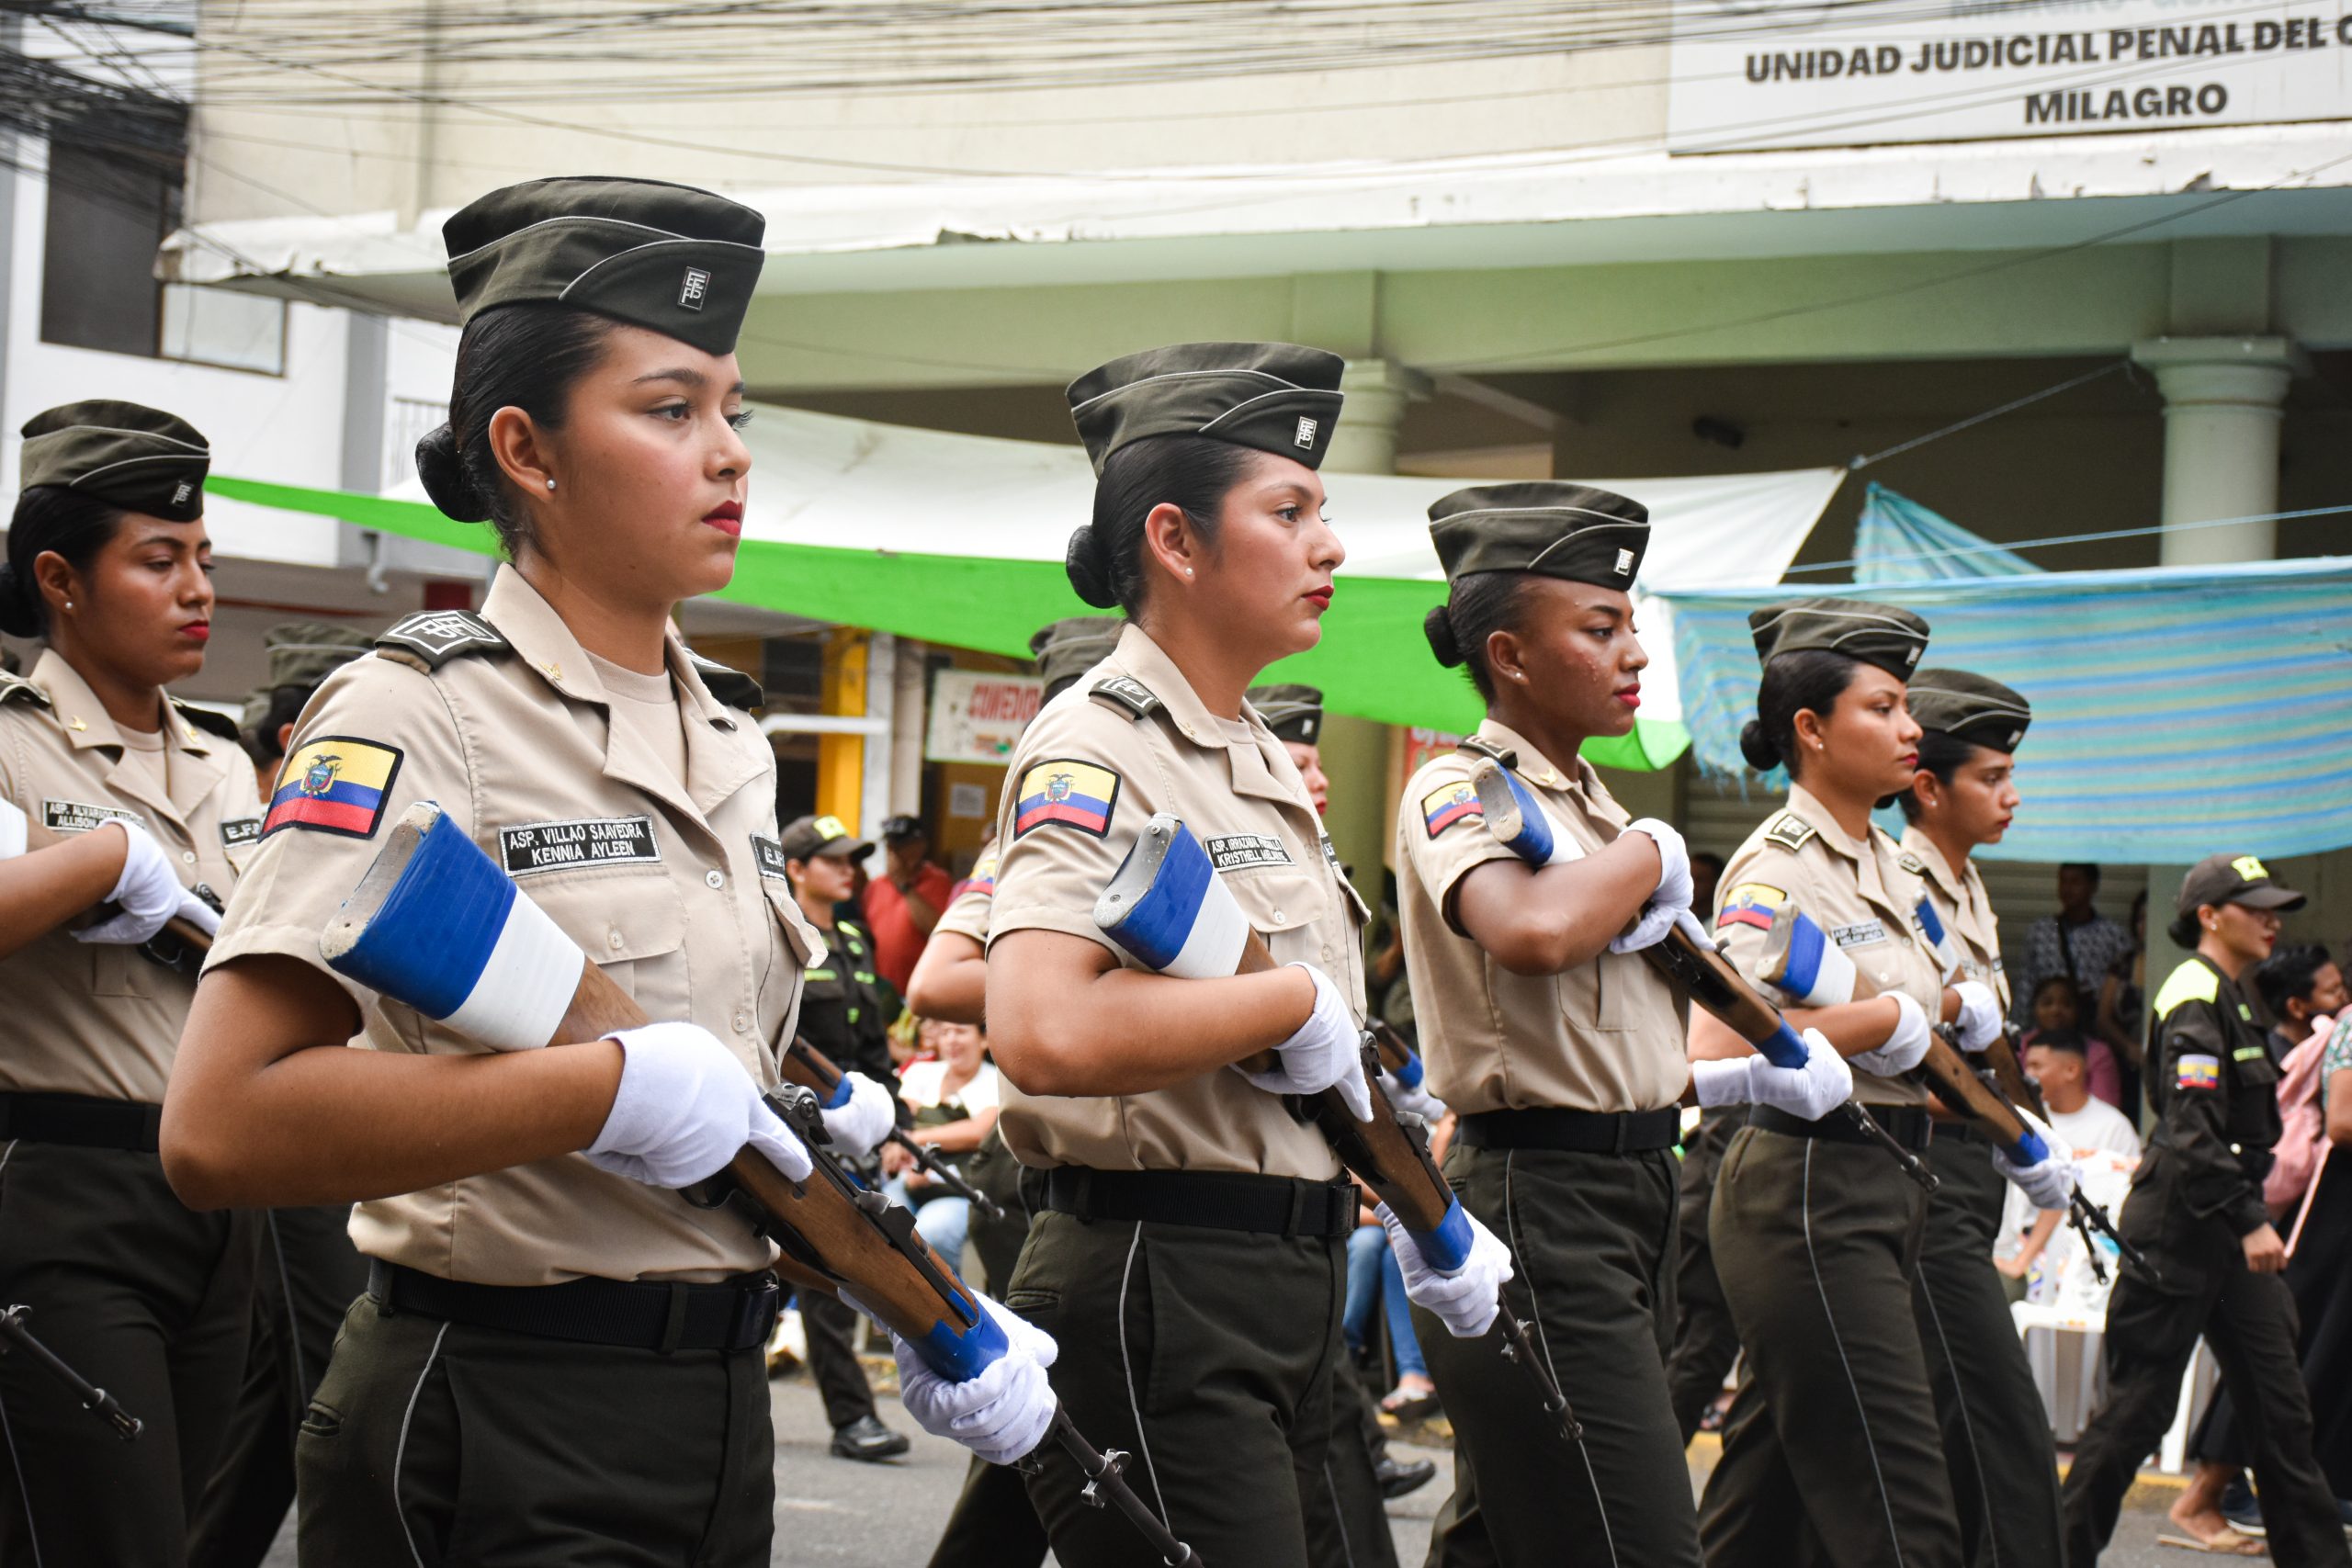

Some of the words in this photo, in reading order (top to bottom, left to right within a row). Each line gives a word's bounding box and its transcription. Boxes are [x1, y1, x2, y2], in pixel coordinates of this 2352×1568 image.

[1746, 45, 1901, 83] UNIDAD
[1910, 32, 2099, 73] JUDICIAL
[2109, 23, 2245, 62] PENAL
[2253, 17, 2327, 51] DEL
[2025, 84, 2228, 124] MILAGRO
[510, 830, 539, 850] ASP.
[542, 825, 586, 844] VILLAO
[590, 823, 645, 840] SAAVEDRA
[1211, 839, 1229, 854] ASP.
[531, 844, 584, 865] KENNIA
[592, 840, 635, 859] AYLEEN
[1217, 849, 1262, 867] KRISTHELL
